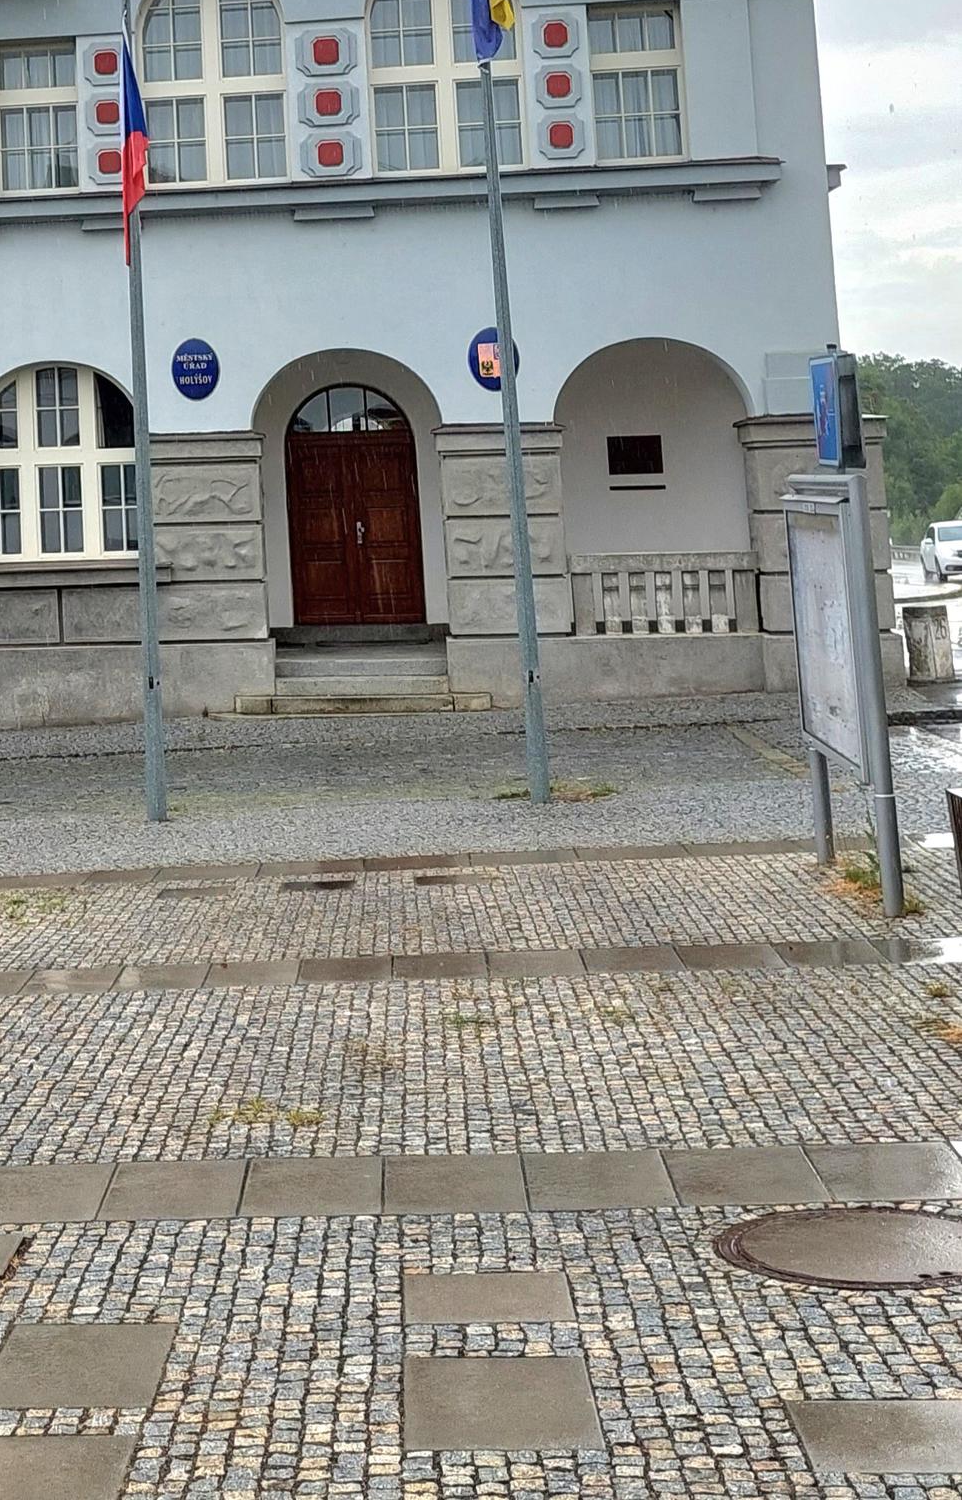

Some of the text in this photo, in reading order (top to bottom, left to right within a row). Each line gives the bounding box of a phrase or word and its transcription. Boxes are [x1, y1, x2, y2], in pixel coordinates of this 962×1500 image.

[176, 353, 213, 362] MĚSTSKÝ
[183, 361, 207, 370] ÚŘAD
[179, 373, 213, 385] HOLÝŠOV
[935, 617, 947, 640] 26
